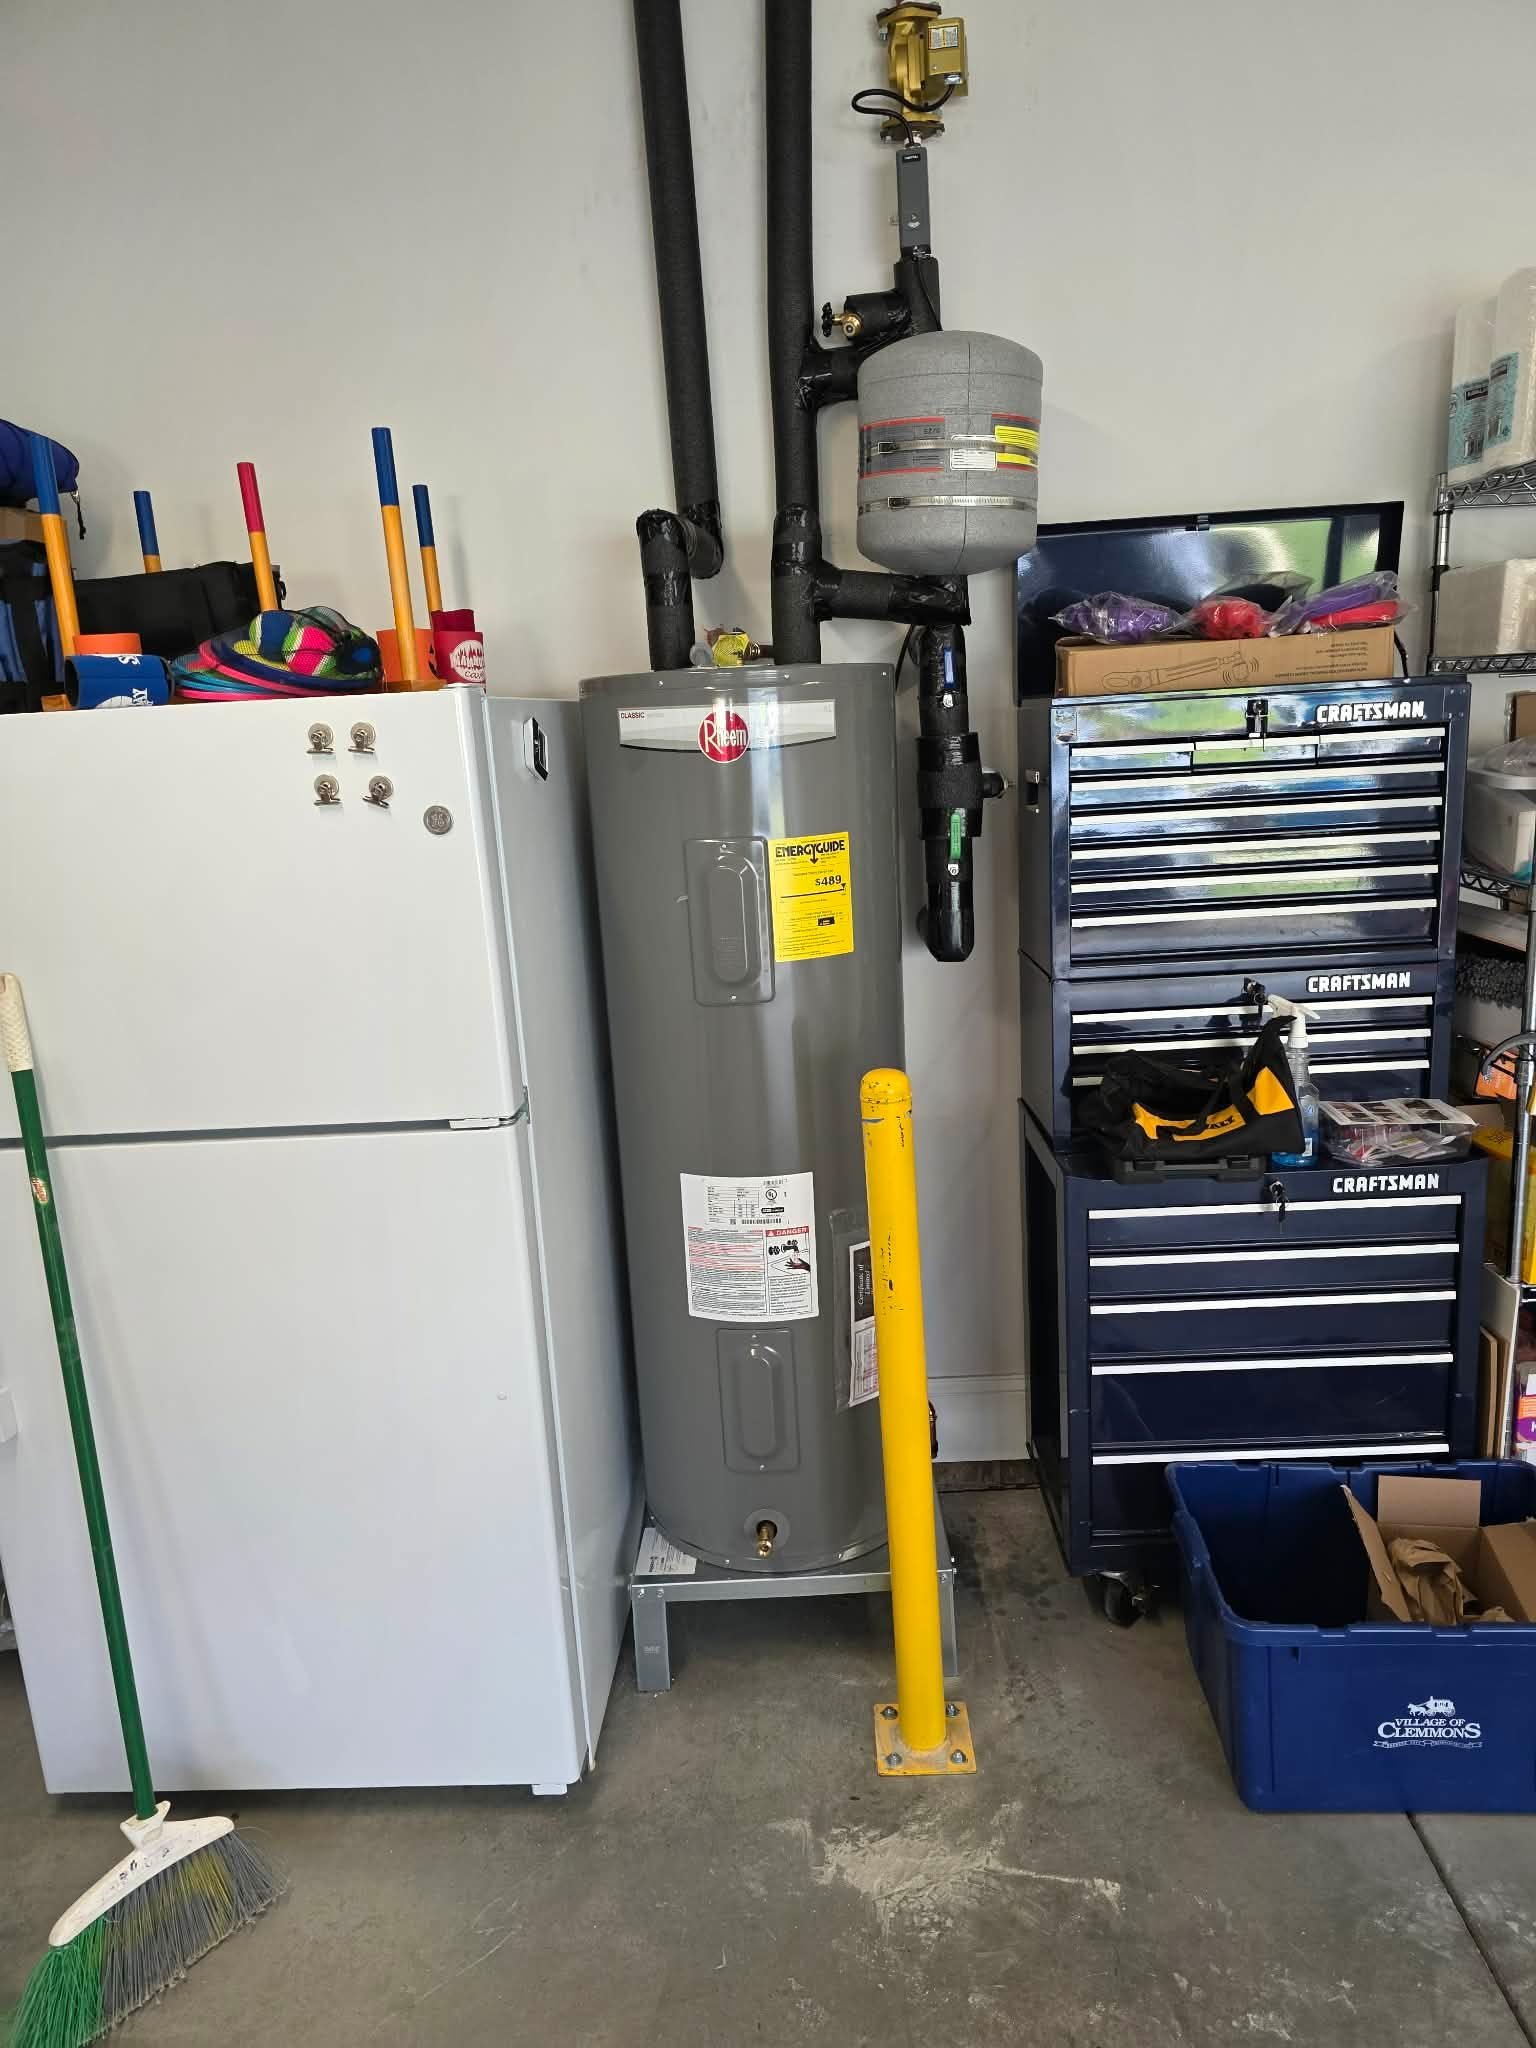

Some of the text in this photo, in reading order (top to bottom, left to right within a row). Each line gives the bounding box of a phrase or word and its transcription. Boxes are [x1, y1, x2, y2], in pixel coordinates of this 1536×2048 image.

[1316, 701, 1425, 723] CRAFTSMAN
[704, 720, 747, 754] Rheem
[815, 875, 842, 887] $489
[1307, 971, 1411, 993] CRAFTSMAN
[1332, 1173, 1440, 1193] CRAFTSMAN
[775, 1227, 807, 1236] DANGER
[1377, 1721, 1482, 1739] CLEMMONS
[1395, 1718, 1466, 1727] VILLAGE OF
